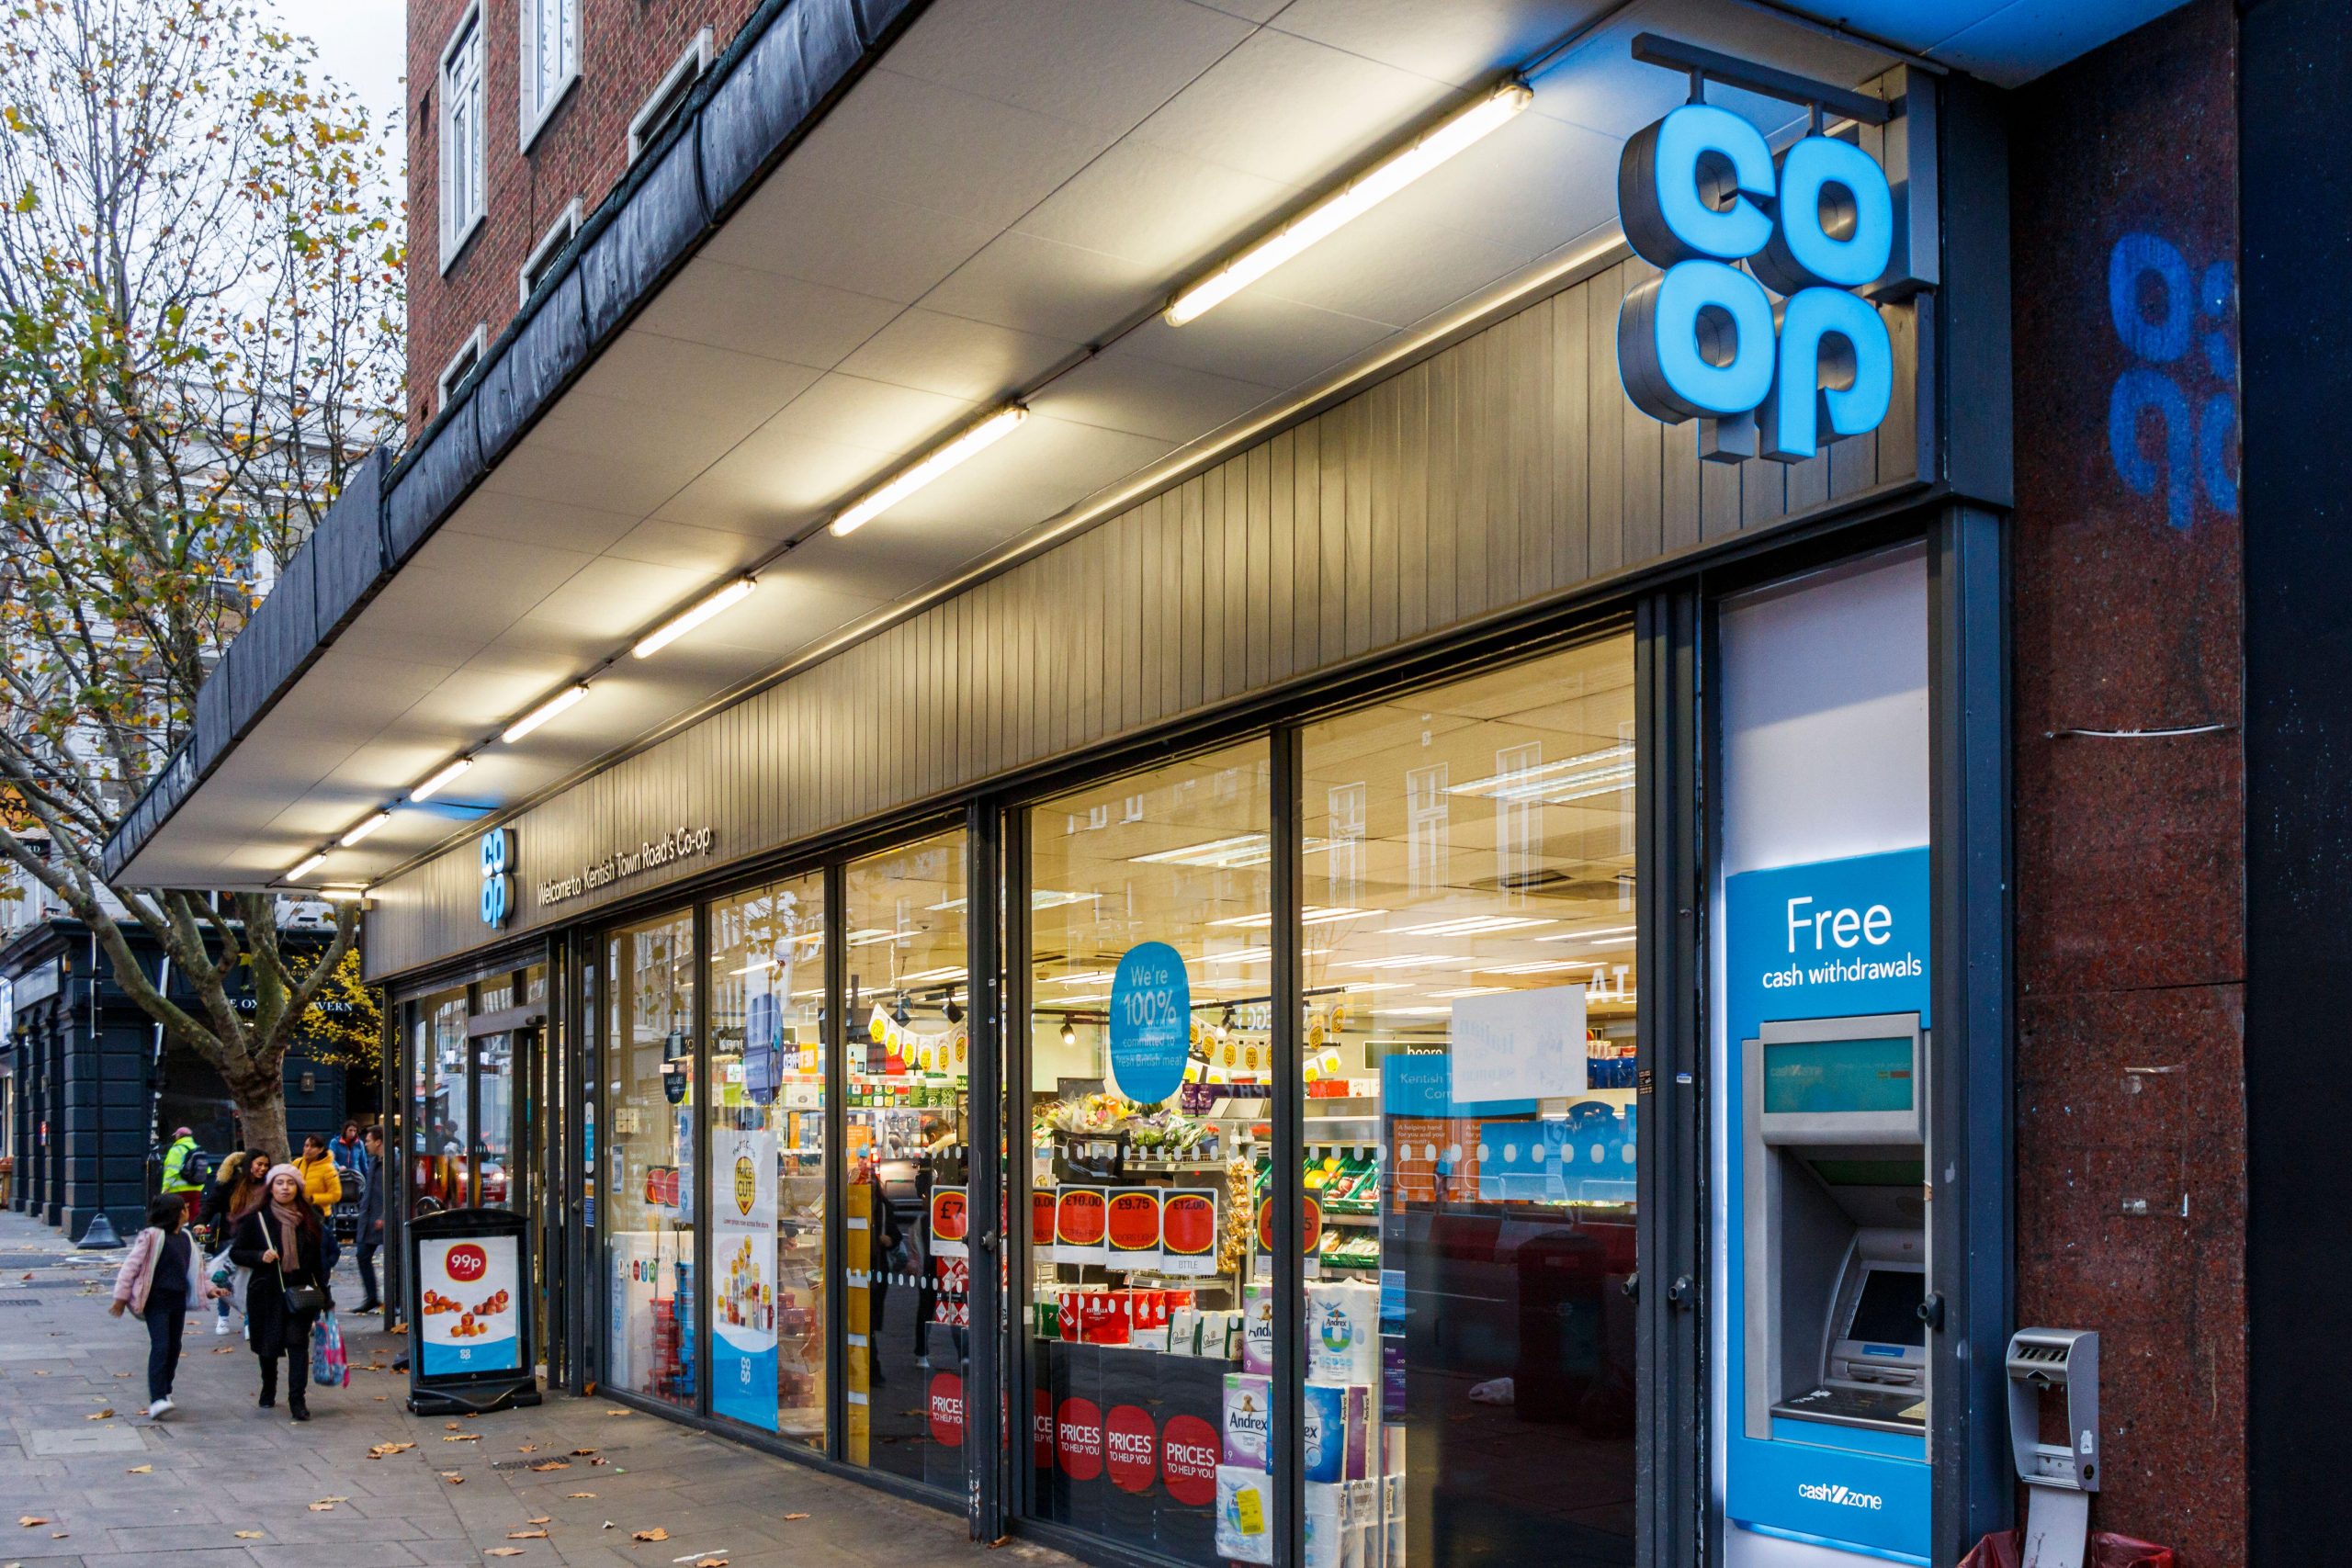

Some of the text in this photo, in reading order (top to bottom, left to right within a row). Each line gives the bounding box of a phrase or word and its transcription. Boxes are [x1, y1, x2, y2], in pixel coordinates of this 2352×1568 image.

[537, 826, 710, 907] Welcome to Kentish Town Road's Co-op
[1788, 896, 1892, 953] Free
[1131, 964, 1168, 987] We're
[1762, 952, 1922, 988] cash withdrawals
[1124, 988, 1176, 1026] 100%
[1123, 1034, 1175, 1047] committed to
[1116, 1054, 1182, 1067] fresh British meat
[1400, 1073, 1442, 1084] Kentish
[738, 1168, 752, 1179] PRICE
[737, 1180, 752, 1198] CUT
[1065, 1196, 1102, 1207] £10.00
[1117, 1198, 1149, 1210] £9.75
[1173, 1200, 1205, 1211] £12.00
[451, 1254, 481, 1271] 99p
[1178, 1260, 1198, 1269] BTTLE
[1326, 1318, 1347, 1327] Andrex
[1246, 1359, 1251, 1369] 9
[933, 1413, 940, 1421] TO
[940, 1414, 952, 1423] HELP
[1229, 1412, 1267, 1431] Andrex
[1060, 1423, 1100, 1445] PRICES
[1108, 1431, 1151, 1454] PRICES
[1061, 1443, 1100, 1456] TO HELP YOU
[1166, 1443, 1216, 1467] PRICES
[1227, 1450, 1233, 1459] 9
[1109, 1451, 1150, 1465] TO HELP YOU
[1167, 1463, 1215, 1479] TO HELP YOU
